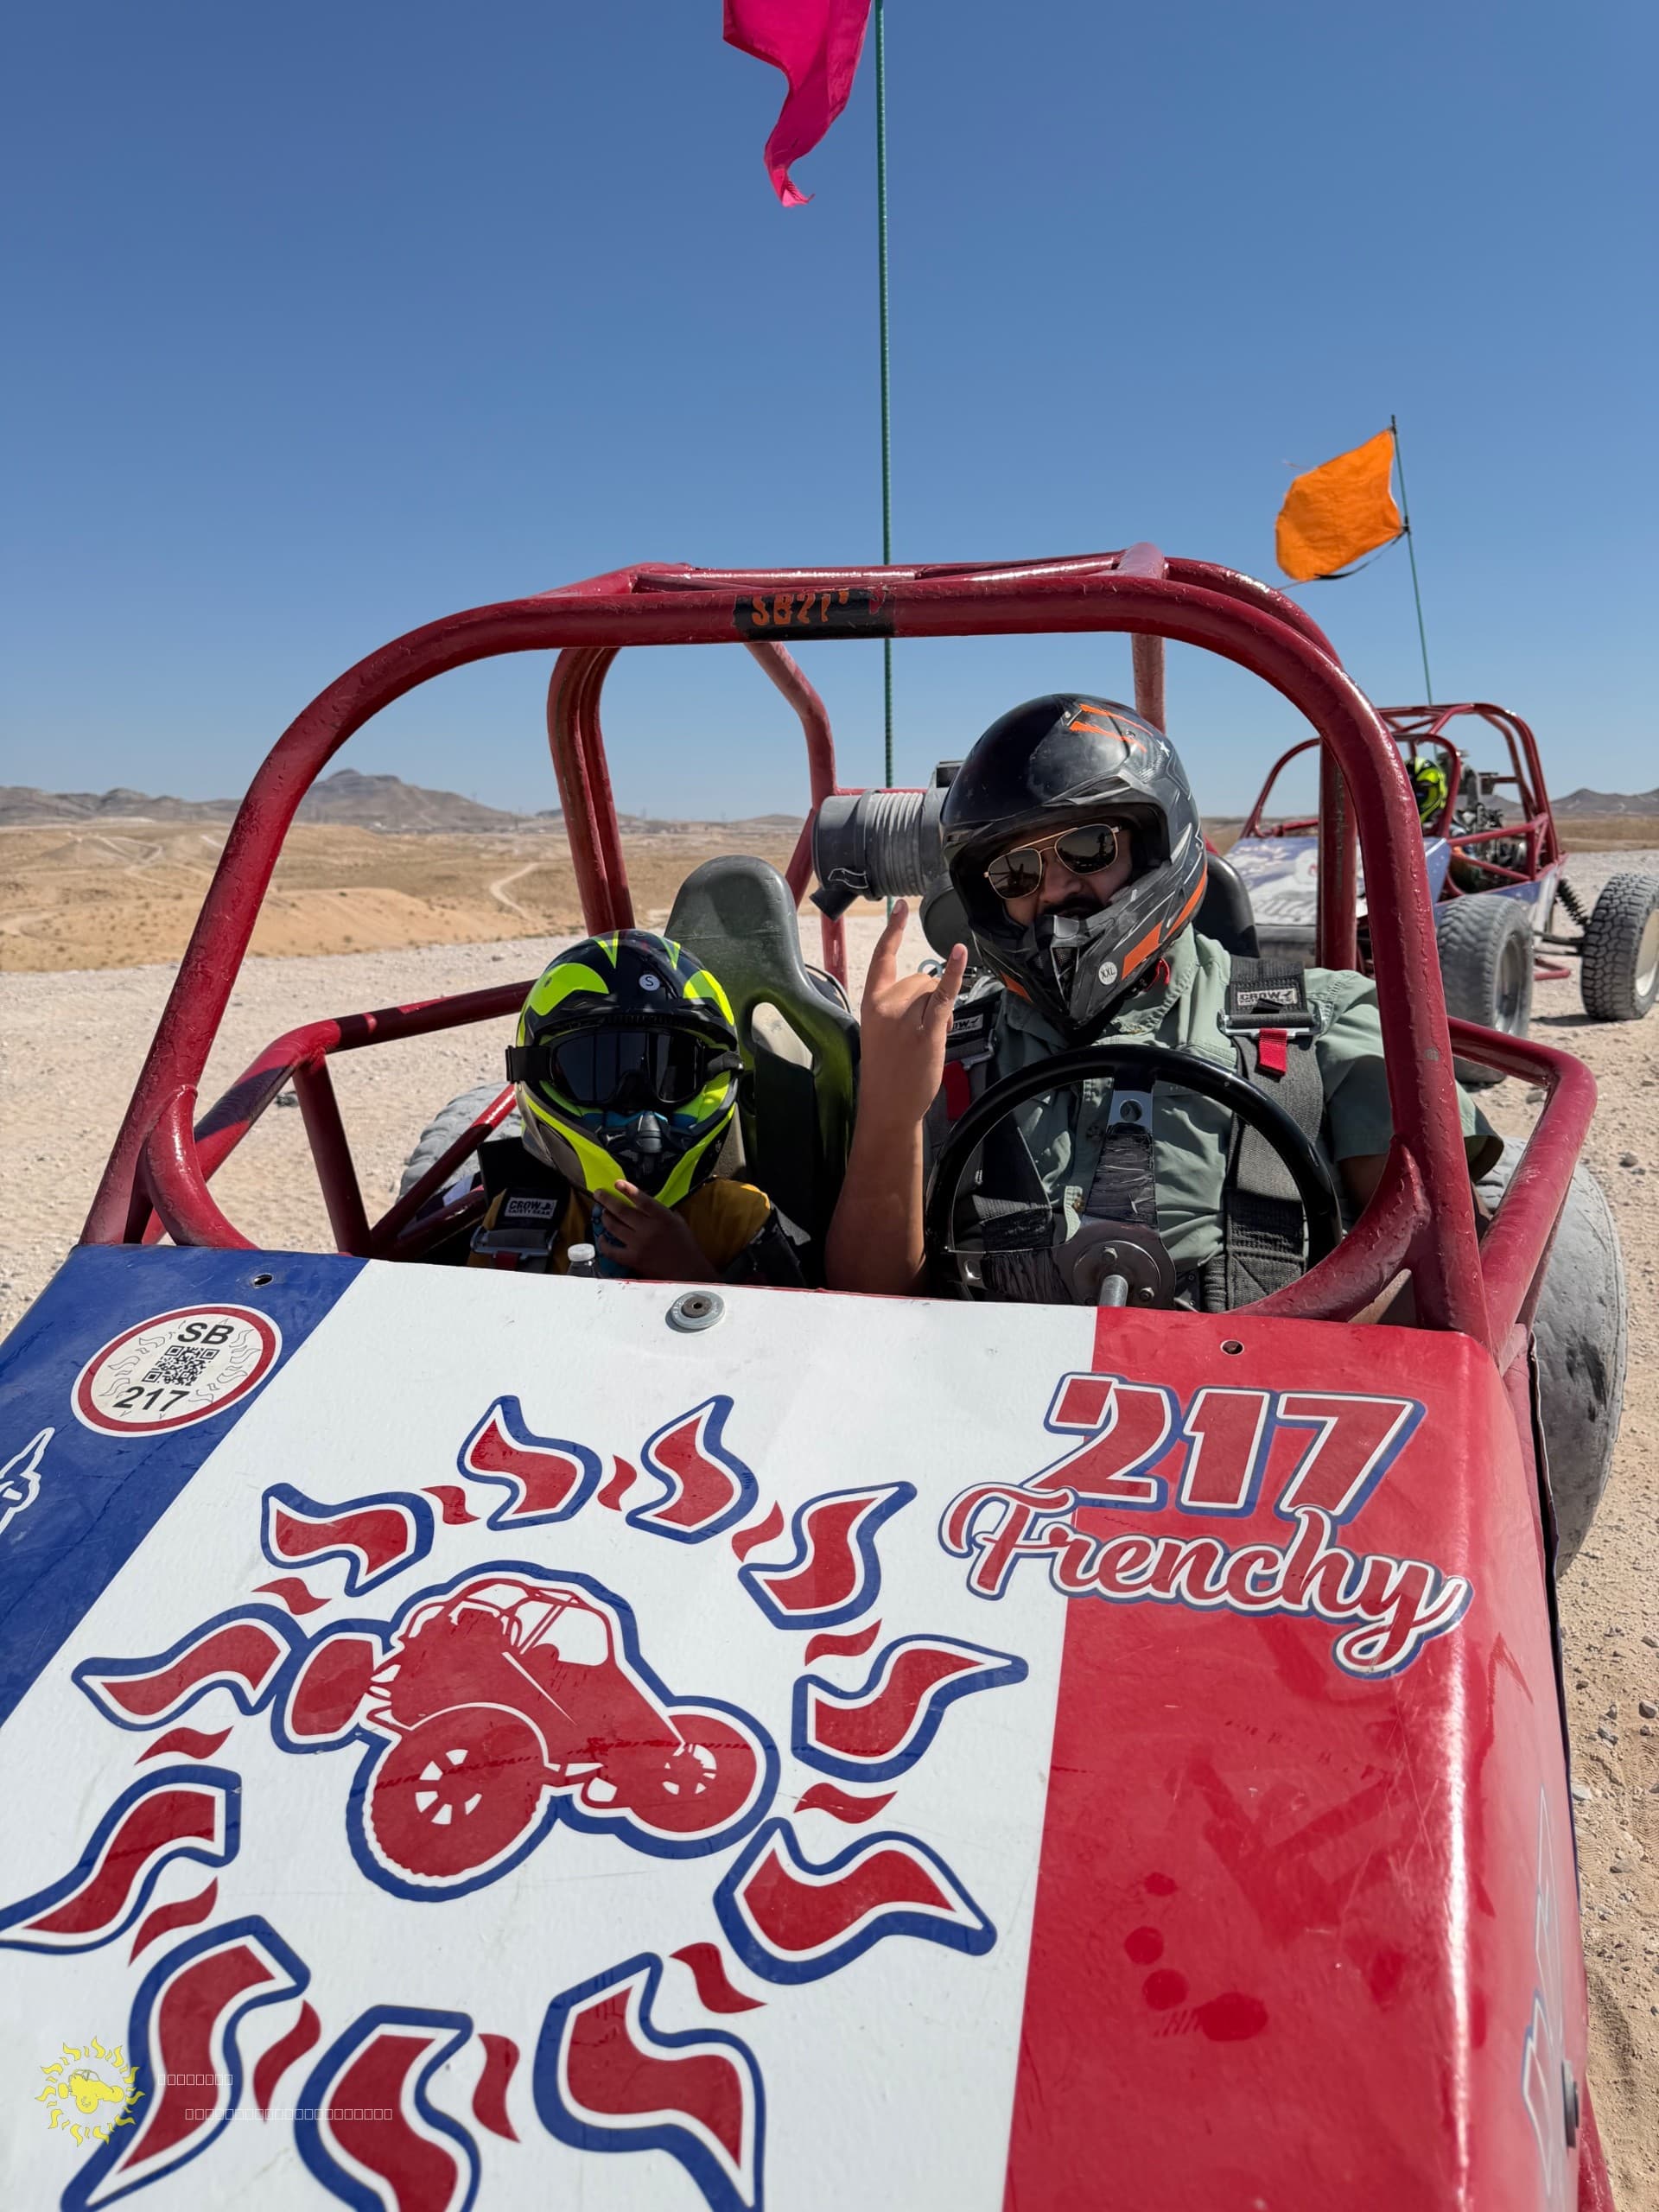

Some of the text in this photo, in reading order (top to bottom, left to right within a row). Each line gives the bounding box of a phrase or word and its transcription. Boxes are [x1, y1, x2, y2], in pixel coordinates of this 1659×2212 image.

[1100, 967, 1116, 978] XXL
[645, 976, 654, 987] S
[1240, 991, 1281, 1001] CROW
[510, 1200, 540, 1211] CROW
[177, 1322, 235, 1344] SB
[112, 1386, 191, 1412] 217
[1022, 1372, 1427, 1526] 217
[938, 1481, 1473, 1680] Frenchy
